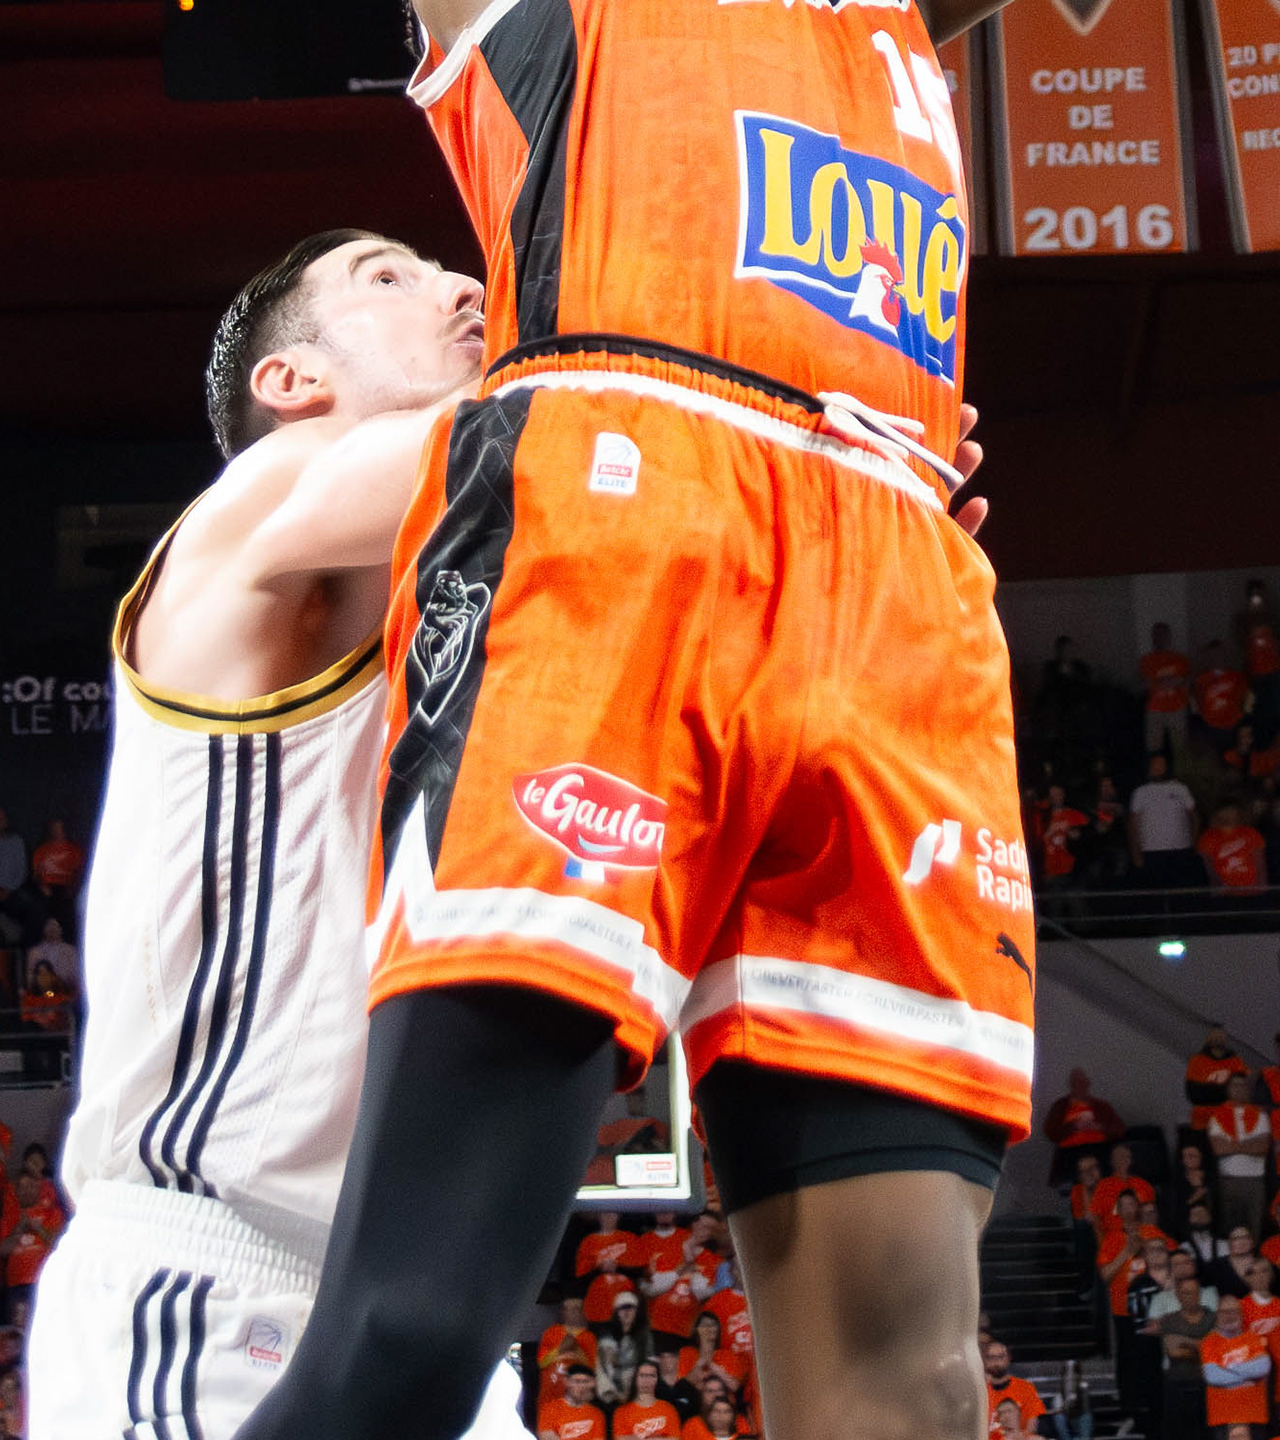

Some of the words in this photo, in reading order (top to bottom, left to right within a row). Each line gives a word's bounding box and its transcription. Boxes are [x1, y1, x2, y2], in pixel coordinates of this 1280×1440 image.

[1031, 66, 1147, 94] COUPE
[1068, 105, 1114, 130] DE
[1026, 140, 1160, 168] FRANCE
[1024, 203, 1174, 252] 2016
